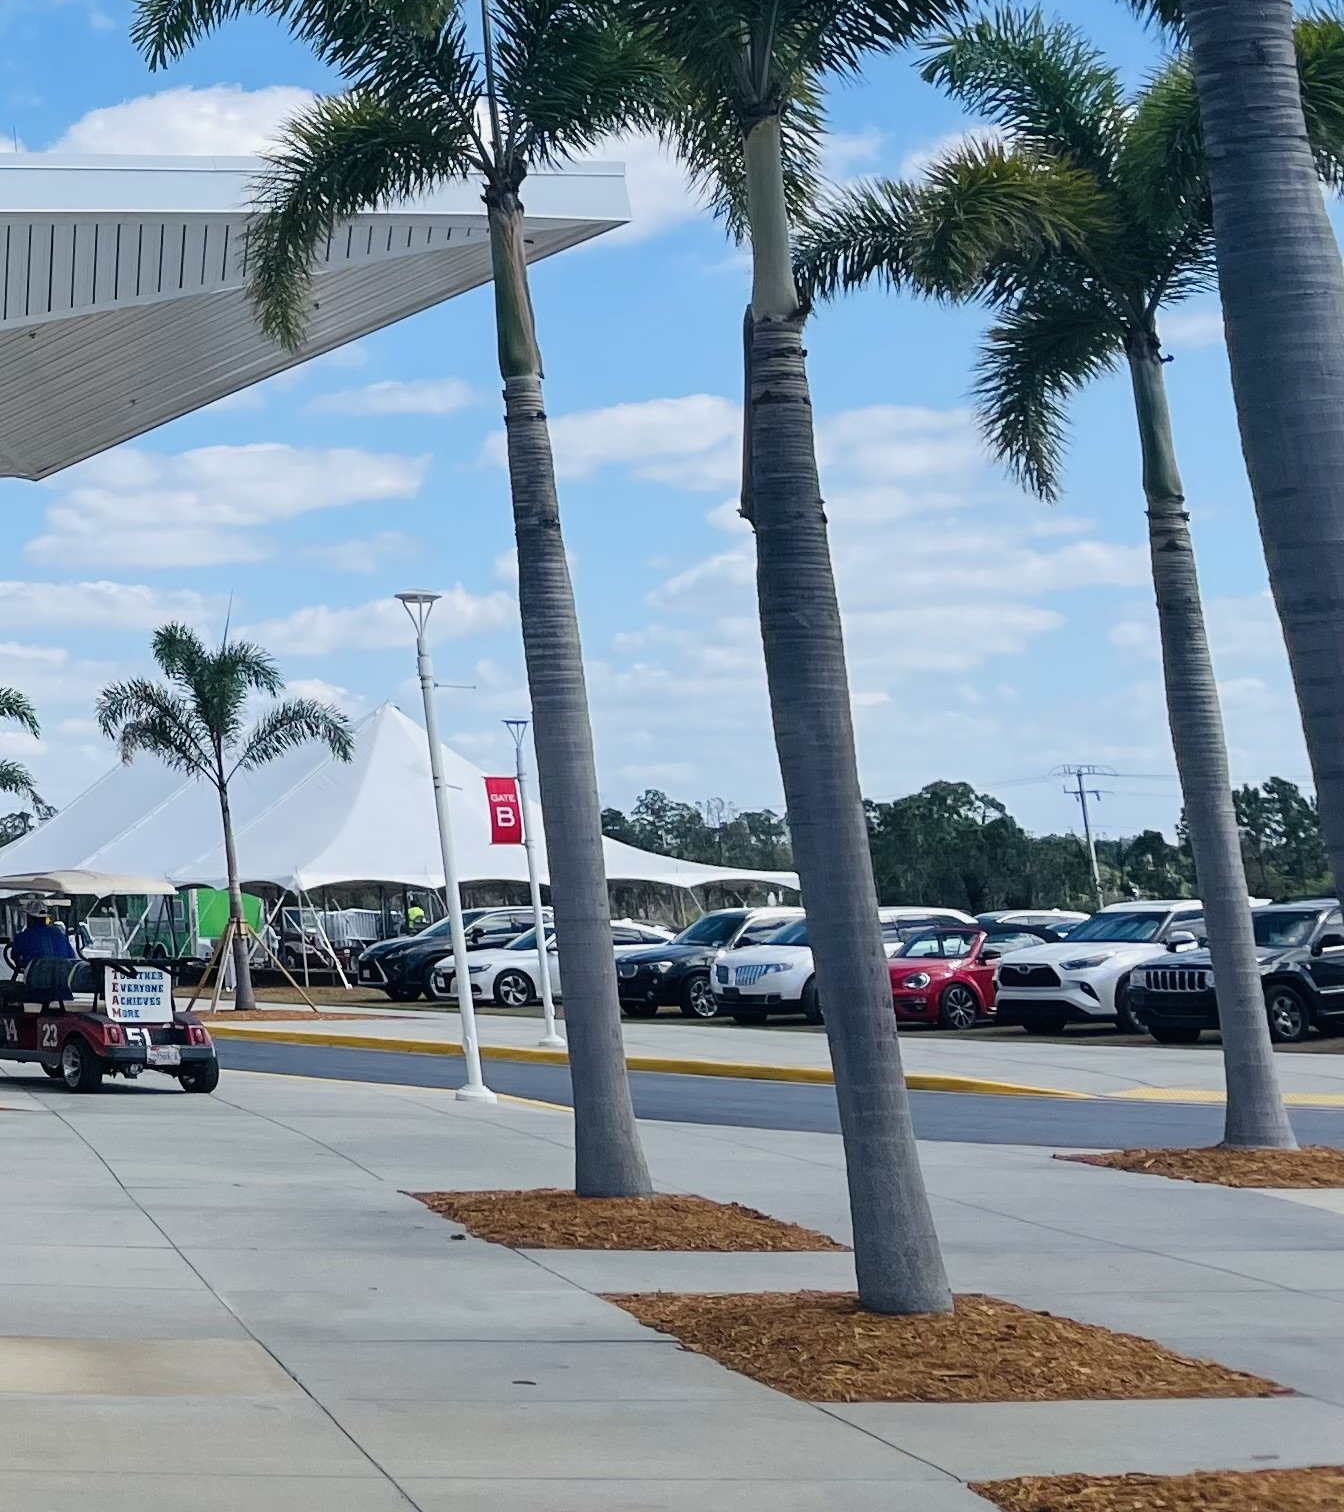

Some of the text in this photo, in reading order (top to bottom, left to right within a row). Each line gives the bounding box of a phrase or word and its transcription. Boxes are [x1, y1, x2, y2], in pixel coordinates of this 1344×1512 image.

[490, 793, 516, 803] GATE
[496, 806, 515, 827] B
[112, 970, 164, 980] TOTHER
[112, 983, 164, 993] EVERYONE
[112, 995, 161, 1006] ACHIEVES
[112, 1008, 140, 1018] MORE
